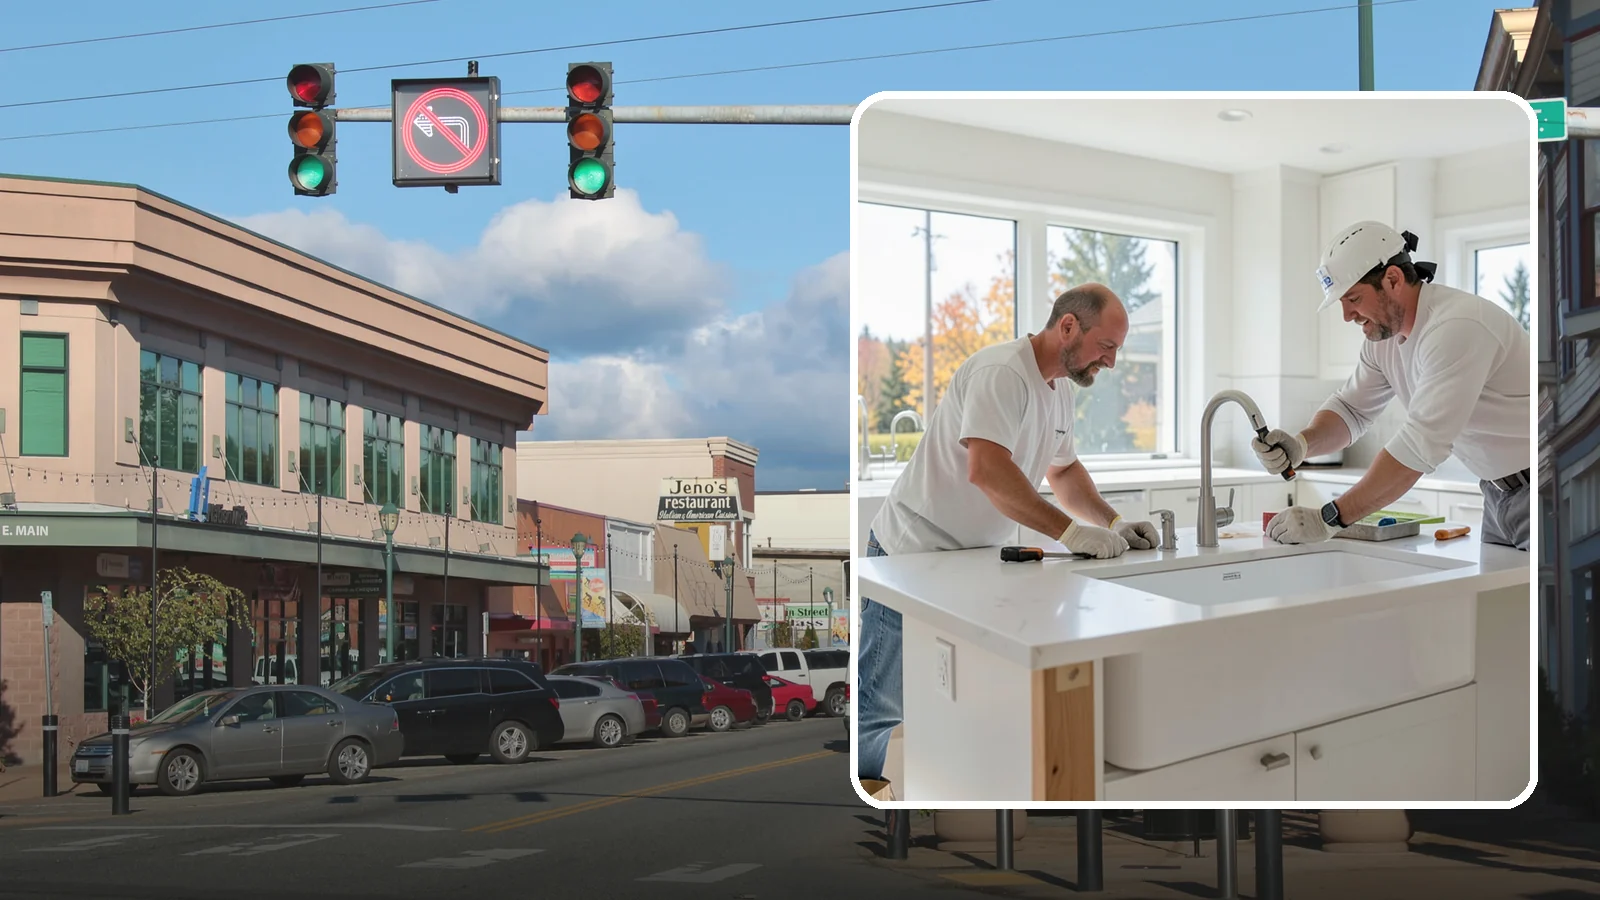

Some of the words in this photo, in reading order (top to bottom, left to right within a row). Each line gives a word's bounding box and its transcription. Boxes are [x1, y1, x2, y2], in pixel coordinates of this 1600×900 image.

[669, 480, 727, 494] Jeno's
[665, 496, 731, 509] restaurant
[659, 510, 681, 520] Italian
[685, 510, 714, 519] American
[715, 510, 737, 519] Cuisine
[2, 525, 13, 536] E.
[15, 525, 49, 536] MAIN
[797, 607, 828, 616] Street
[791, 619, 823, 627] lass
